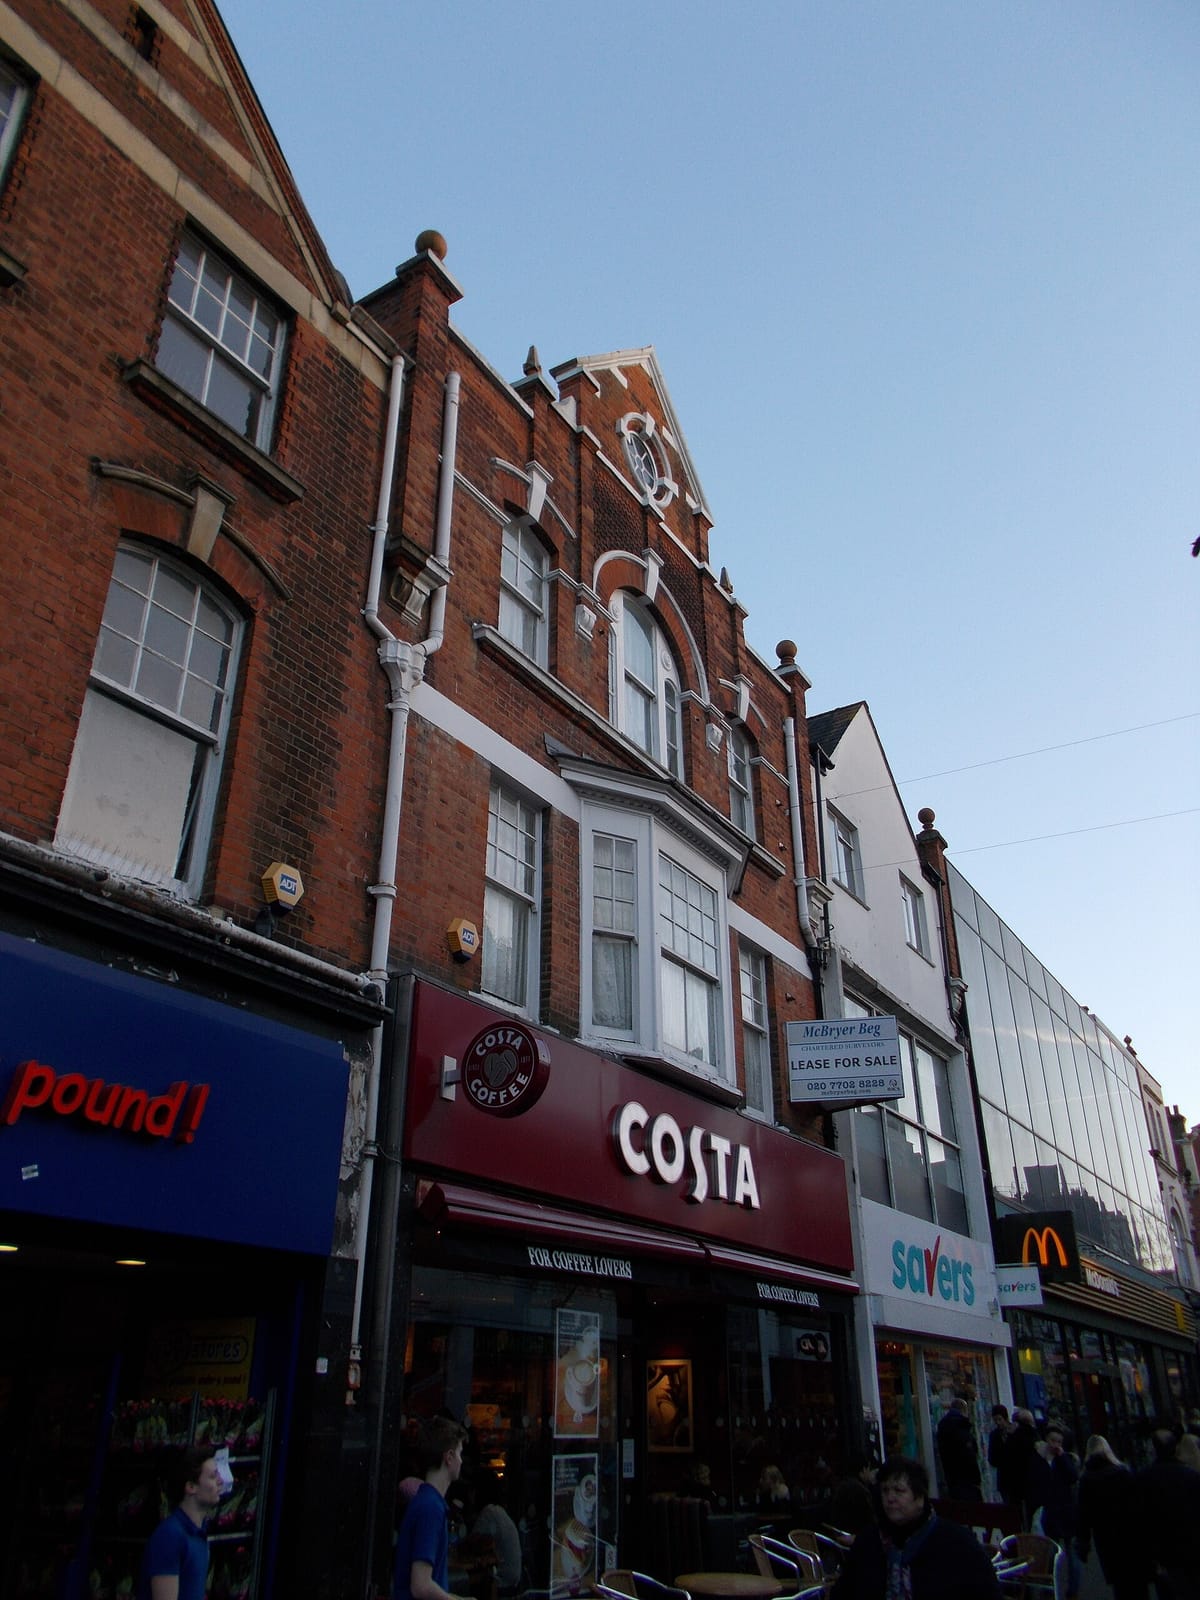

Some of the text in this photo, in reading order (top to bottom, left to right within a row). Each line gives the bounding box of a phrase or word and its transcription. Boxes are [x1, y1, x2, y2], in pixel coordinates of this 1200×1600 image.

[280, 877, 297, 893] ADT
[463, 930, 475, 944] ADT
[803, 1023, 881, 1039] McBryer Beg
[475, 1030, 523, 1057] COSTA
[791, 1055, 897, 1070] LEASE FOR SALE
[470, 1072, 529, 1104] COFFEE
[807, 1079, 885, 1091] 020 7702 8228
[618, 1100, 761, 1210] COSTA
[527, 1246, 632, 1279] FOR COFFEE LOVERS
[892, 1234, 975, 1307] savers
[756, 1282, 772, 1299] FOR
[795, 1290, 820, 1308] LOVERS
[998, 1281, 1036, 1293] savers
